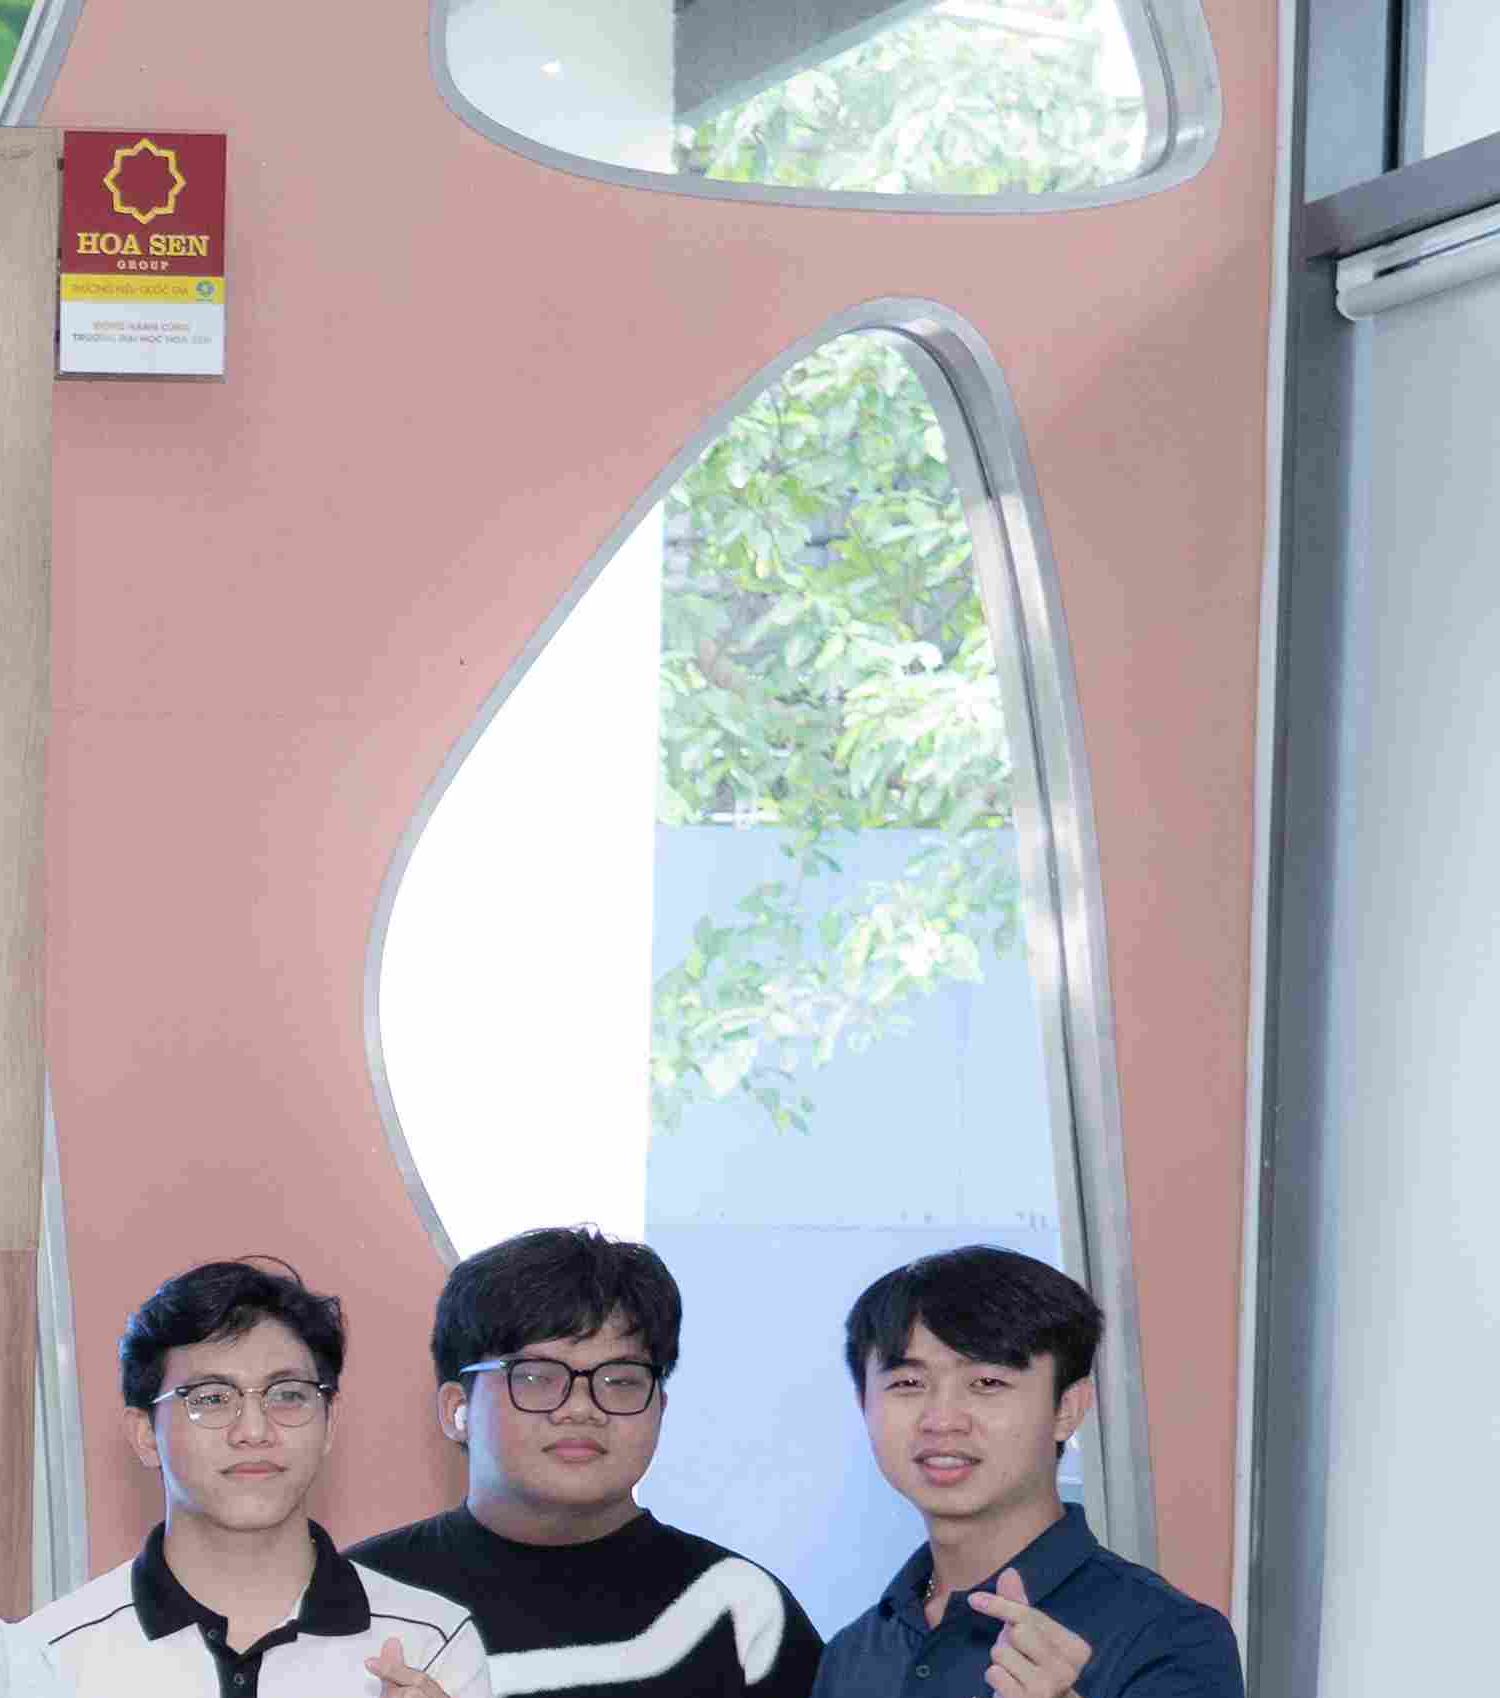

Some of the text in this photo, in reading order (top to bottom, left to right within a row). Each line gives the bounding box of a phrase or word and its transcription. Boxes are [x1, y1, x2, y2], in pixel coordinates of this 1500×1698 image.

[76, 232, 209, 256] HOA SEN
[117, 260, 169, 271] GROUP
